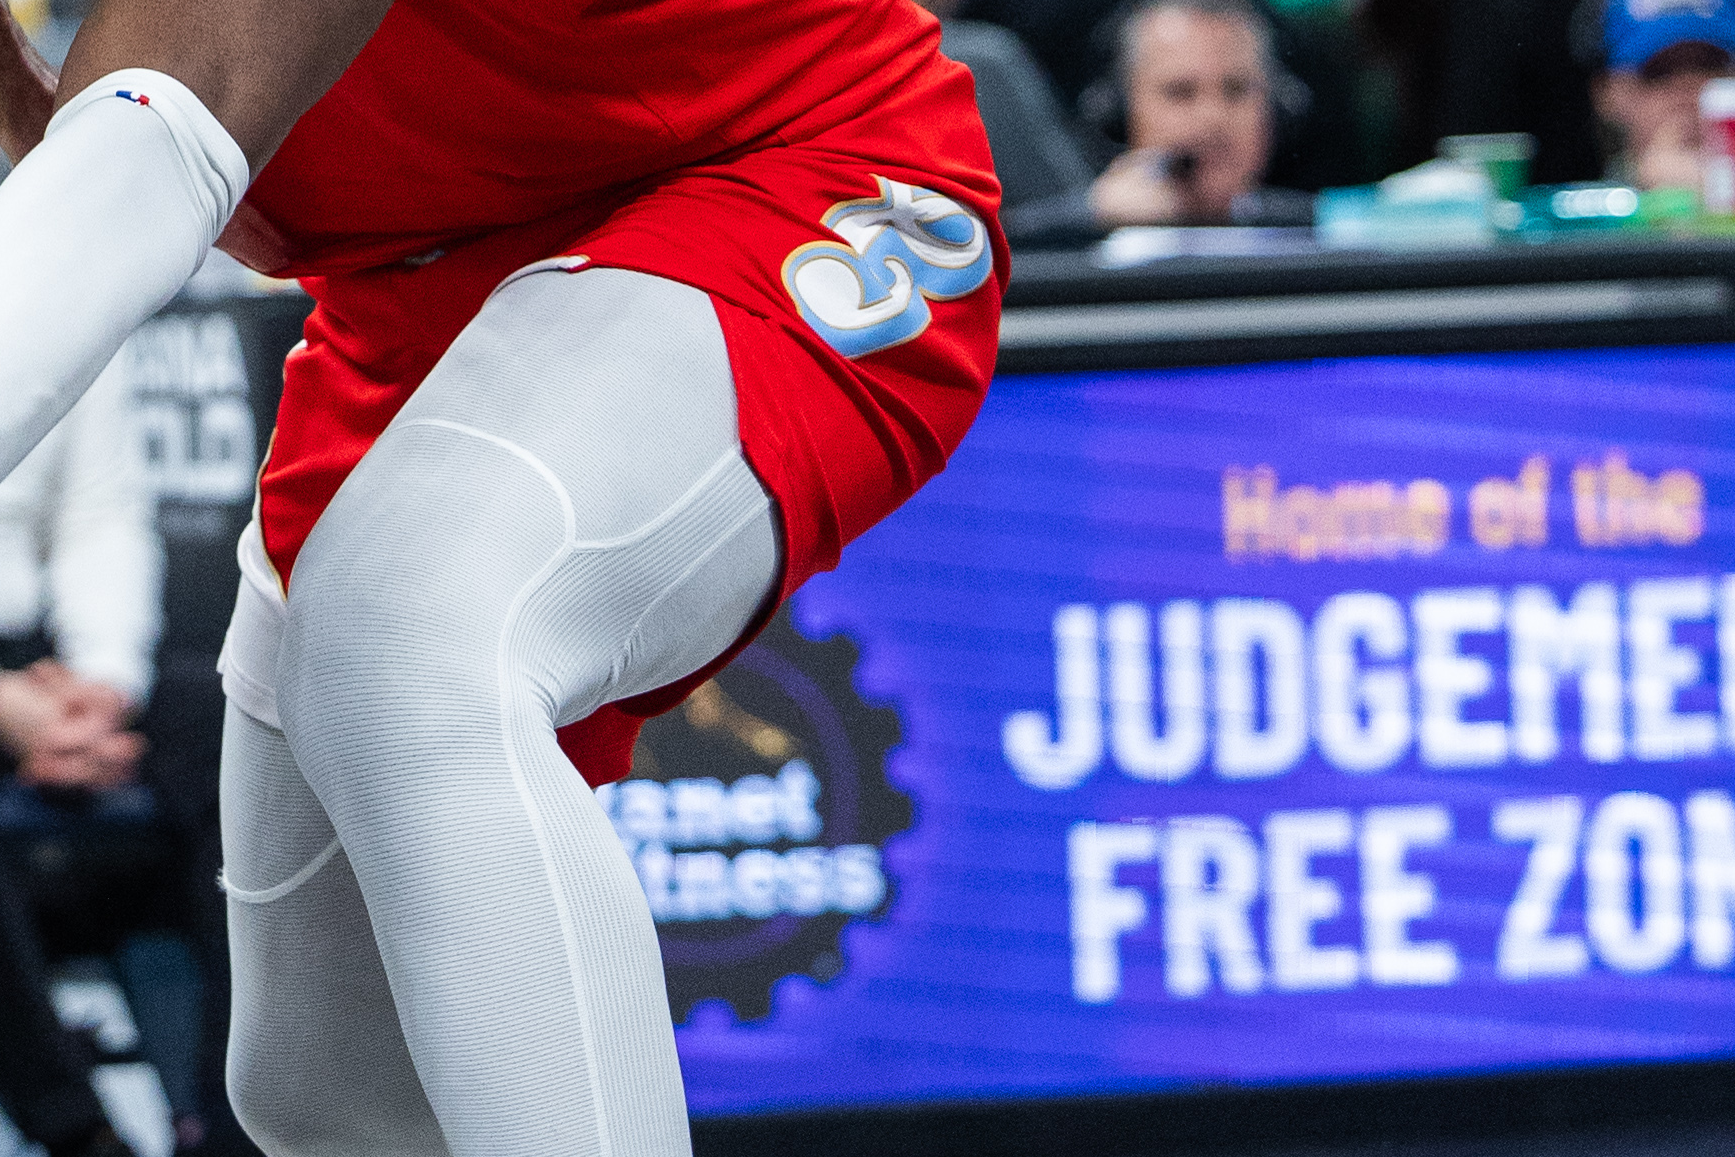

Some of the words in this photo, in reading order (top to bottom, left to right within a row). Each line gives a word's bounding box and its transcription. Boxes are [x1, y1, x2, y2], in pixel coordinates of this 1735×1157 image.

[1221, 464, 1451, 562] Home
[1470, 454, 1550, 547] of
[1571, 448, 1704, 548] the
[1002, 571, 1735, 791] JUDGEME
[597, 758, 823, 849] anet
[627, 840, 887, 924] tness
[1070, 804, 1459, 1006] FREE
